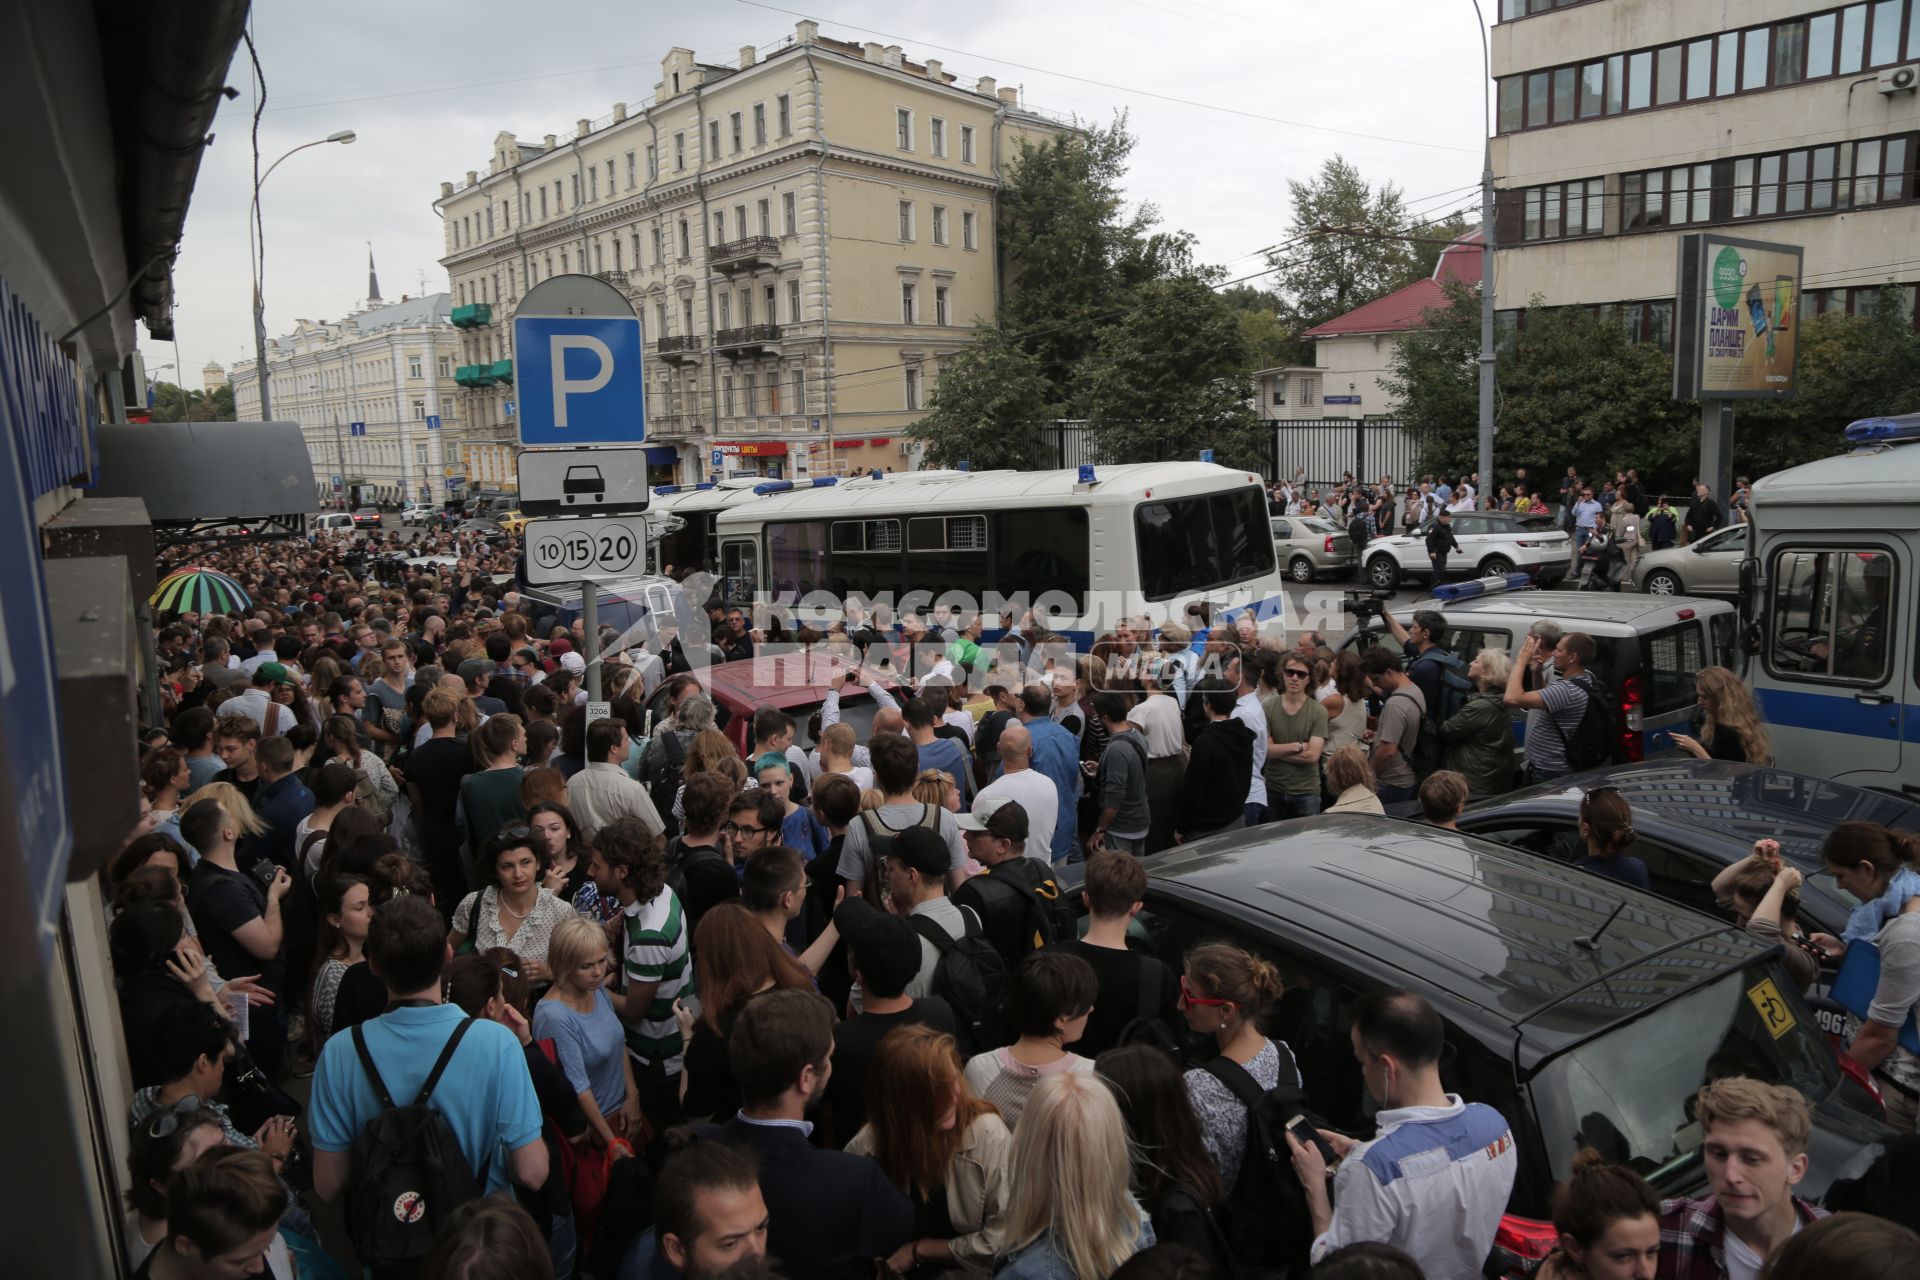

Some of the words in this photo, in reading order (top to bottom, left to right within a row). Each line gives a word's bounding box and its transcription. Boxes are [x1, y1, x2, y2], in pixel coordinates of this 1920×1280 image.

[1711, 307, 1739, 327] ДАРИМ
[1709, 328, 1746, 348] ПЛАНШЕТ
[549, 334, 615, 428] P
[539, 543, 559, 561] 10
[566, 538, 590, 561] 15
[599, 535, 632, 562] 20
[589, 707, 609, 716] 3206
